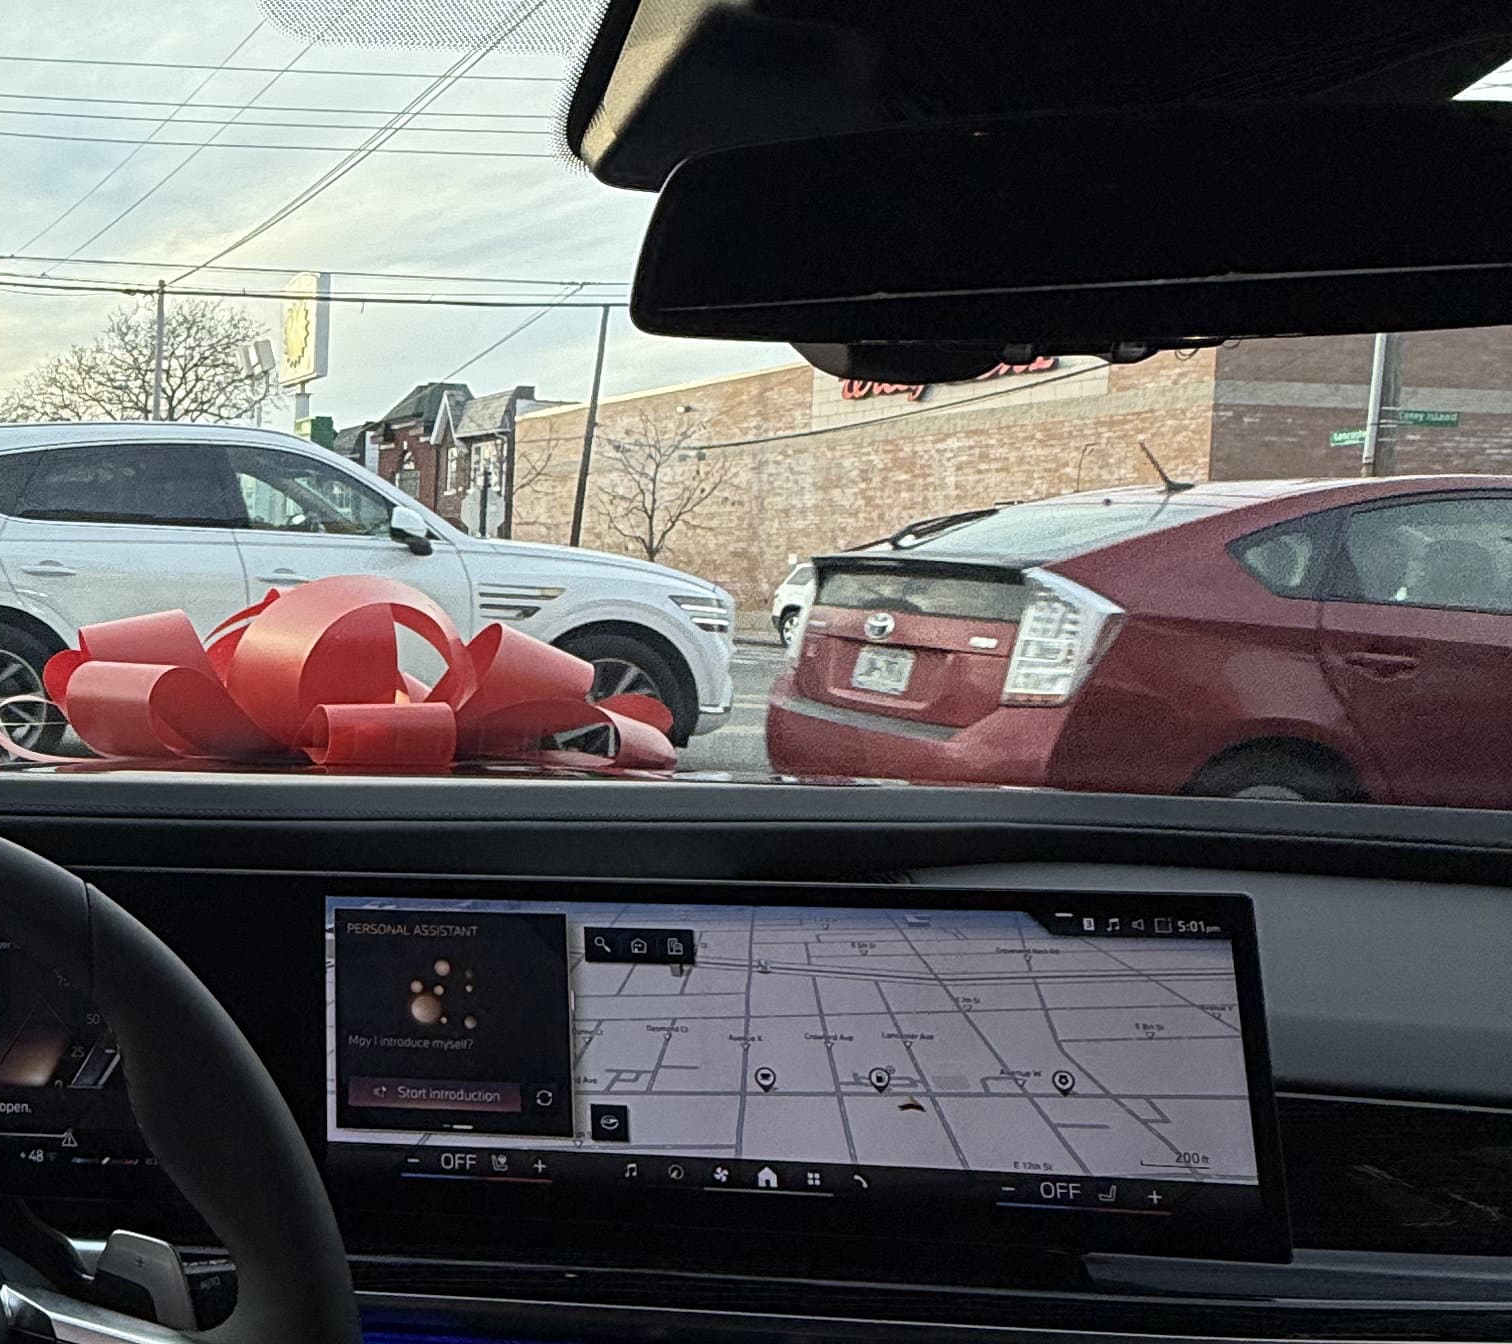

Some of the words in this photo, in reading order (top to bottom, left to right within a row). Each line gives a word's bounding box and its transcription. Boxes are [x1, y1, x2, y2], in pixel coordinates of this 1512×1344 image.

[347, 922, 410, 935] PERSONAL
[413, 924, 479, 937] ASSISTANT
[1178, 920, 1205, 933] 5:01
[86, 1013, 100, 1025] 50
[349, 1036, 372, 1048] May
[380, 1037, 430, 1049] introduce
[432, 1039, 473, 1051] myself?
[71, 1046, 85, 1057] 25
[397, 1086, 426, 1100] Start
[429, 1087, 501, 1103] introduction
[441, 1152, 477, 1170] OFF
[1175, 1152, 1200, 1164] 200
[1039, 1182, 1081, 1200] OFF
